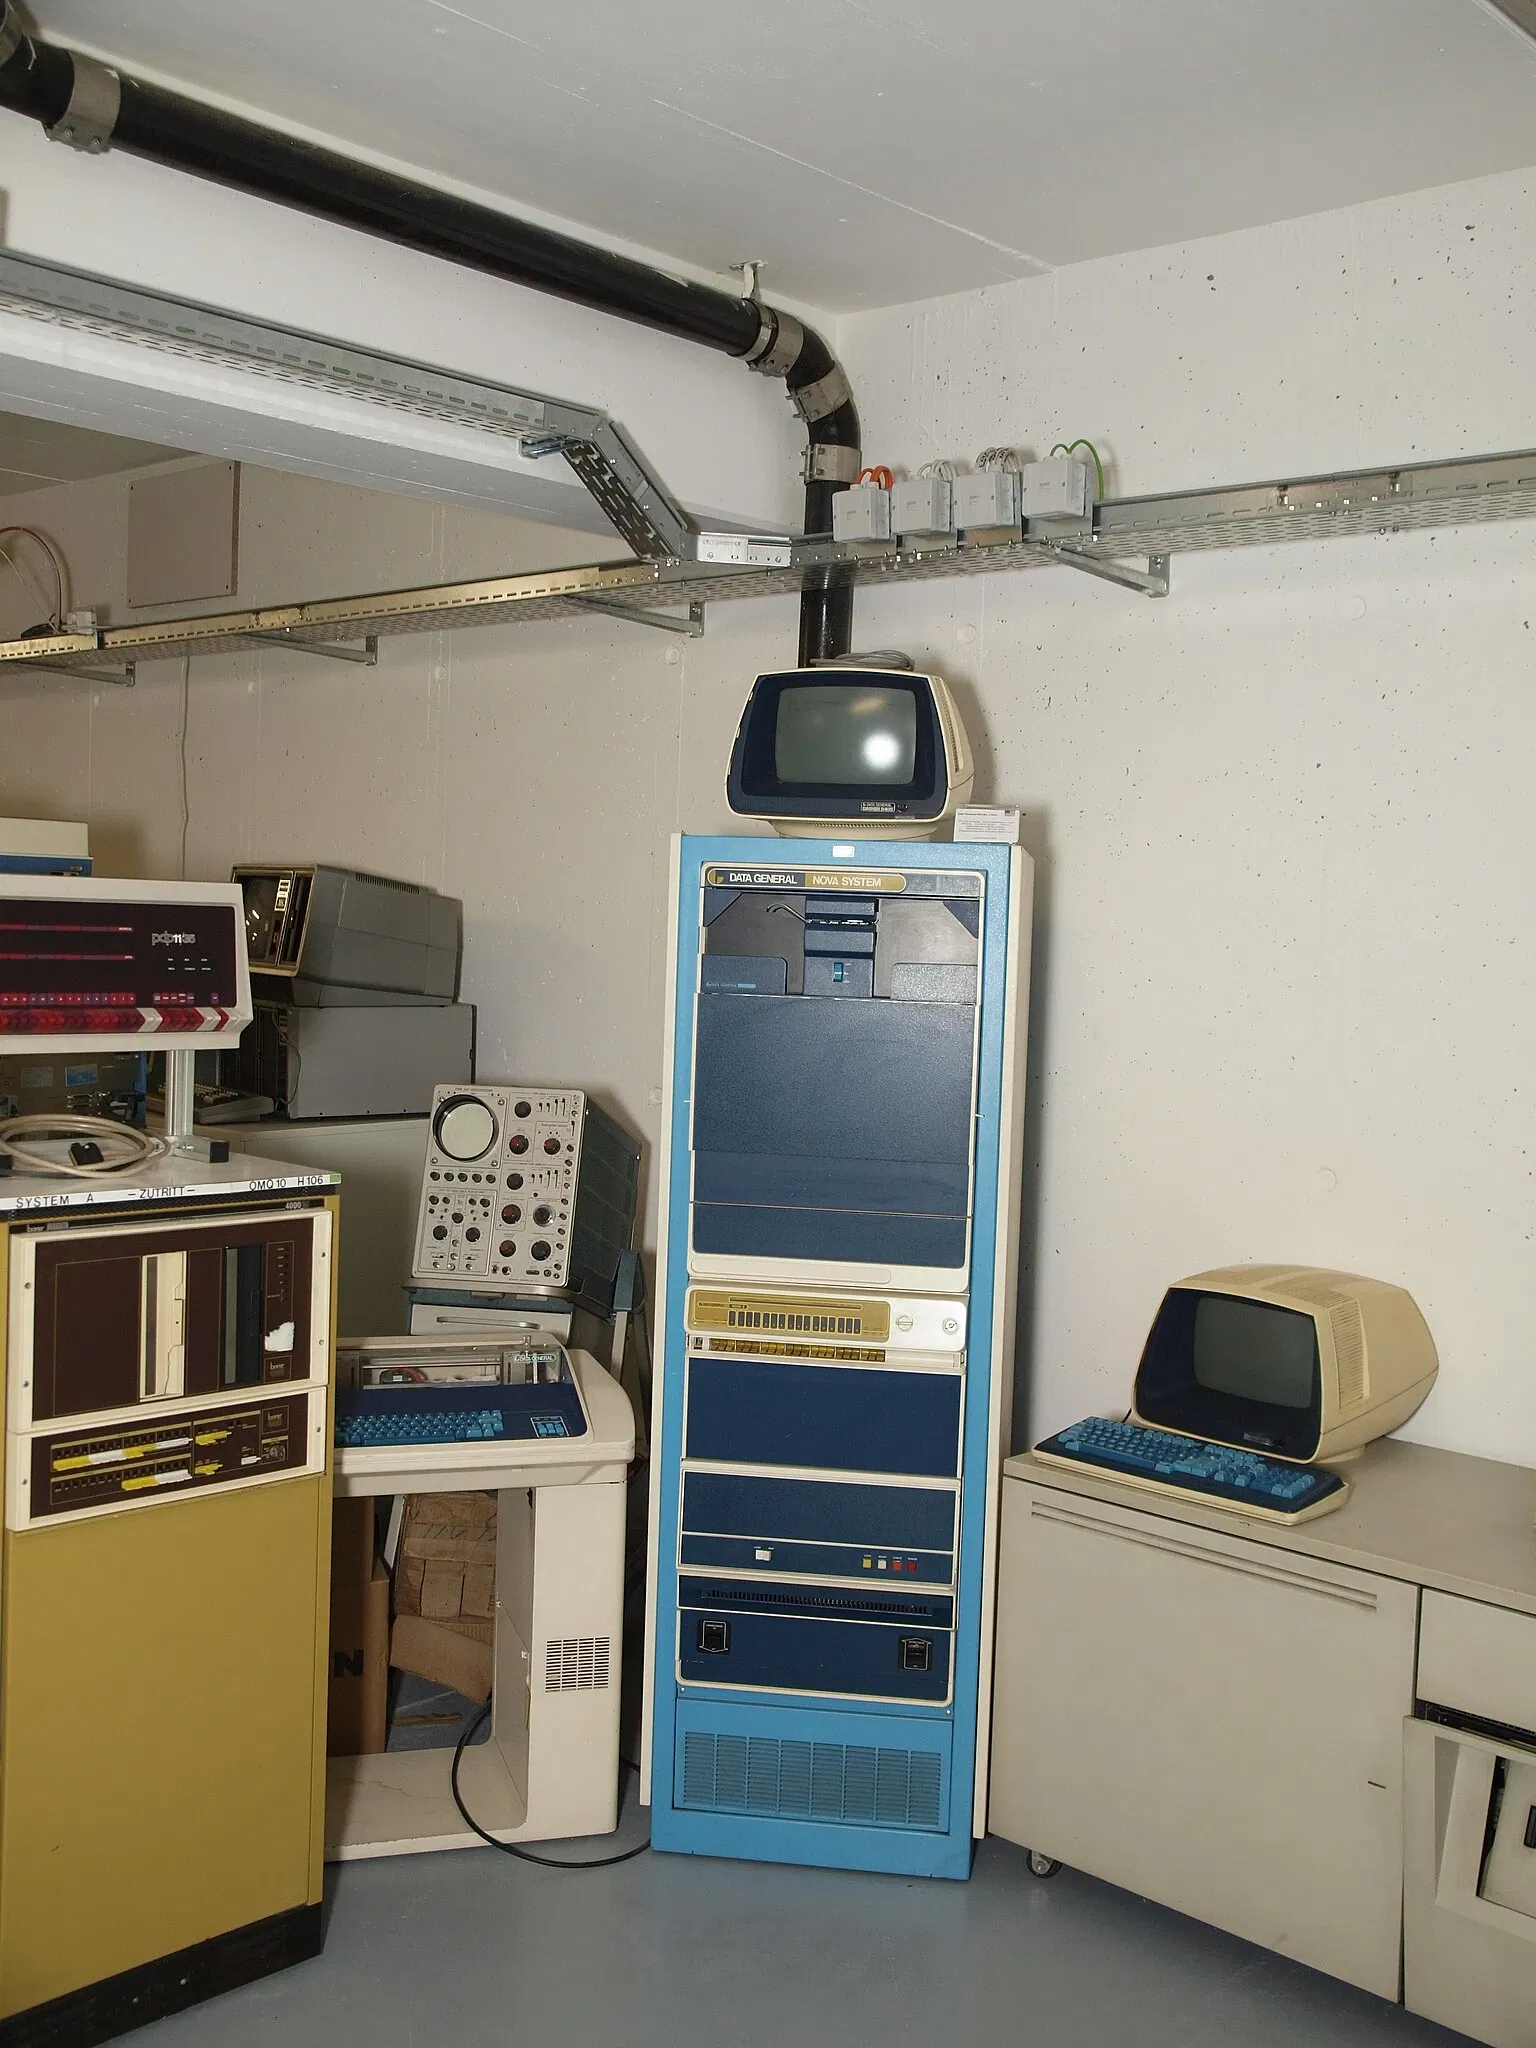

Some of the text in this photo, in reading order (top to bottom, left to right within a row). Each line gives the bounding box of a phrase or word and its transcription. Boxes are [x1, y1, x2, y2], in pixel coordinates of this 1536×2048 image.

[729, 872, 882, 887] DATA GENERAL NOVA SYSTEM
[16, 1195, 70, 1209] SYSTEM
[86, 1193, 94, 1203] A
